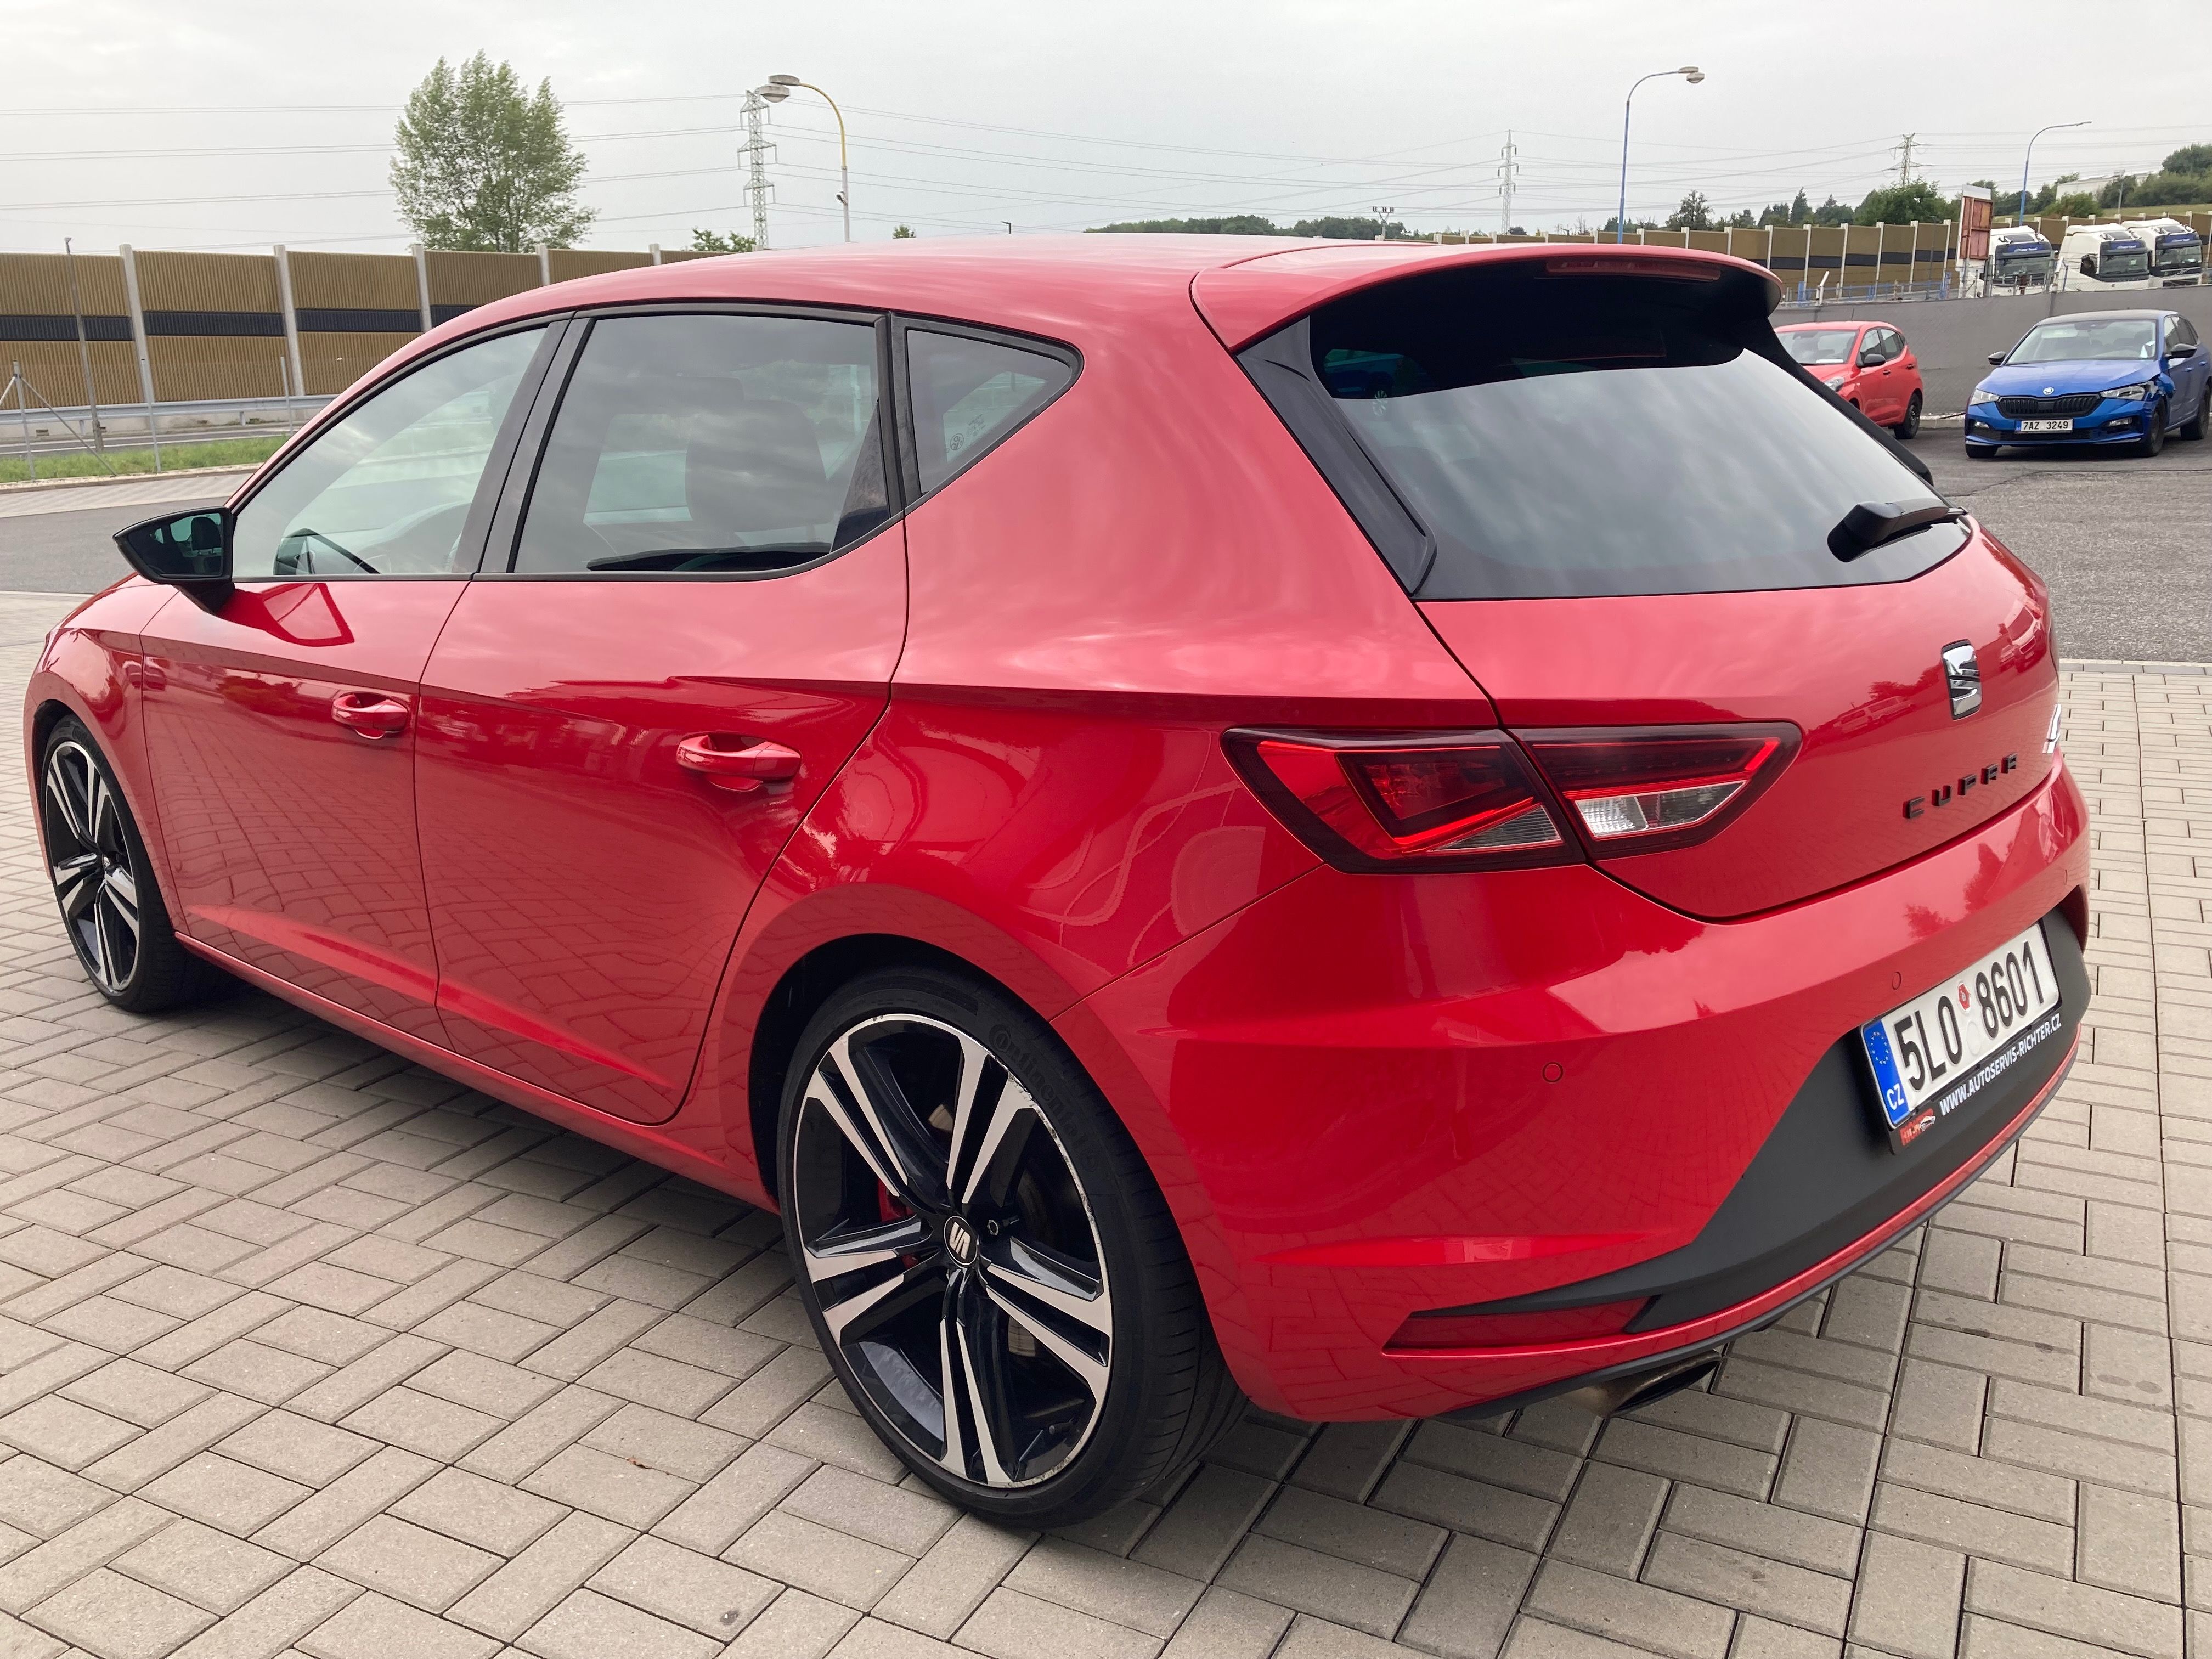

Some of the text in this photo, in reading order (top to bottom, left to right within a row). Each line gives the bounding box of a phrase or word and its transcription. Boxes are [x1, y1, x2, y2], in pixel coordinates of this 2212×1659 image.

[2023, 421, 2068, 430] 7AZ 3249
[1903, 752, 2018, 819] CUPRA
[1975, 940, 2044, 1039] 8601
[1886, 1083, 1905, 1111] CZ
[1939, 1013, 2062, 1116] WWW.AUTOSERVIS-RICHTER.CZ
